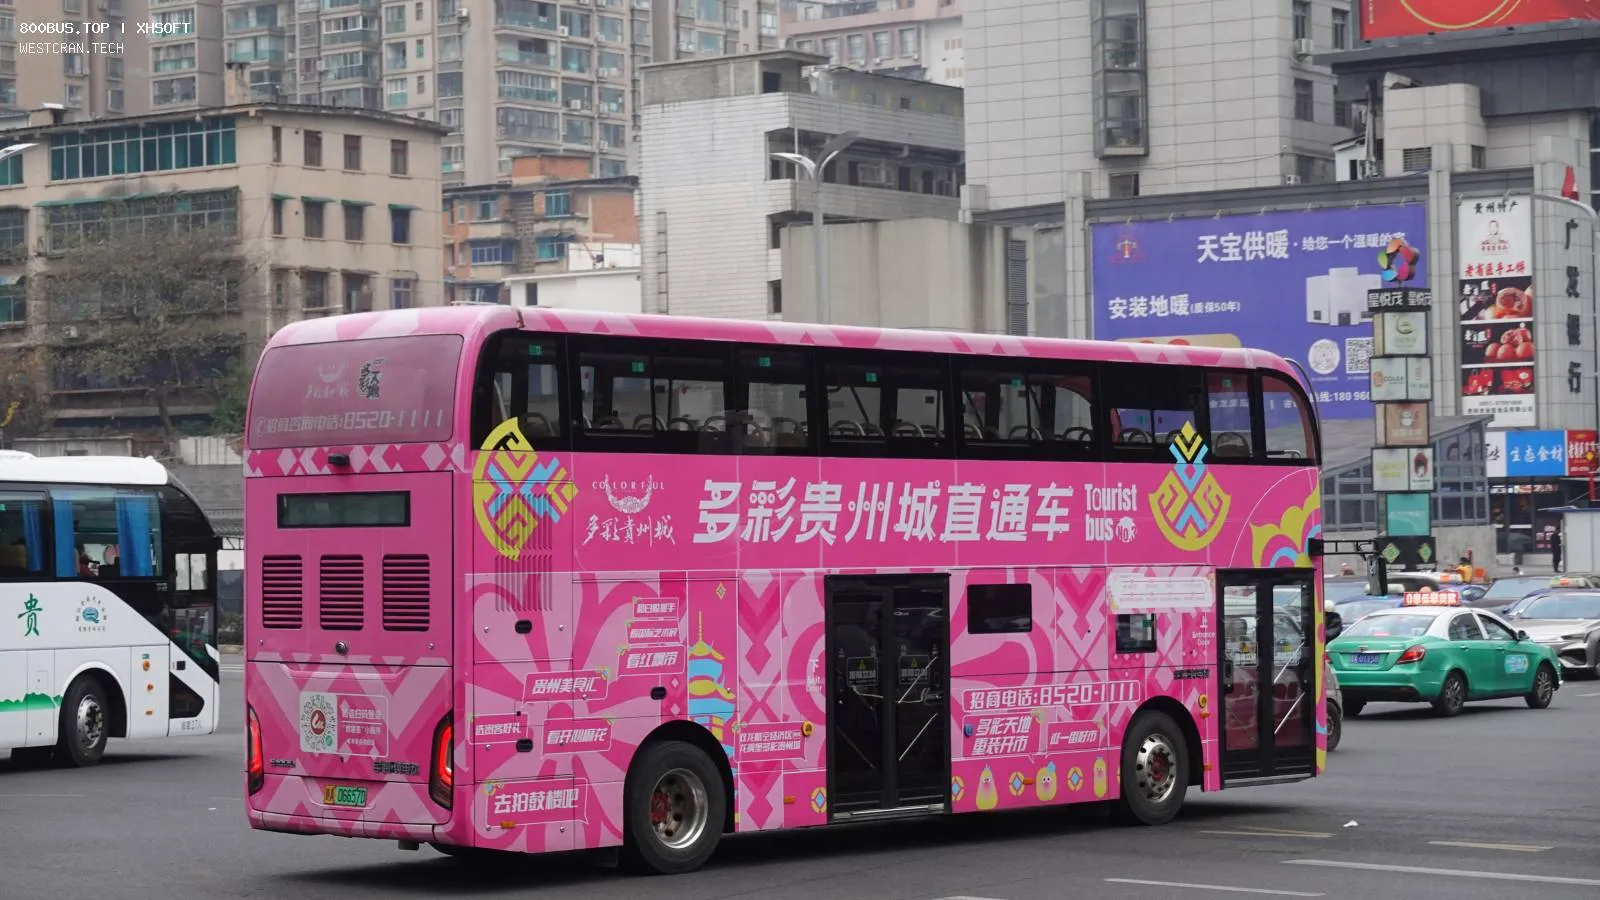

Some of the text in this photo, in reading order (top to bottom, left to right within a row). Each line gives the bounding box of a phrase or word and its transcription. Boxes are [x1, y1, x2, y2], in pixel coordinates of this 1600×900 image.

[1196, 229, 1289, 263] 天宝供暖
[1108, 294, 1189, 319] 安装地暖
[1510, 444, 1563, 463] 生态食材
[1085, 482, 1137, 512] Tourist
[693, 476, 1074, 545] 多彩贵州城直通车
[1085, 514, 1114, 542] bus
[17, 593, 43, 636] 贵
[626, 651, 678, 669] 看红飘带
[532, 677, 597, 695] 贵州美食汇
[546, 728, 607, 746] 看开心麻花
[976, 716, 1032, 736] 多彩天地
[972, 736, 1028, 756] 重装开市
[494, 789, 578, 813] 去拍鼓楼吧
